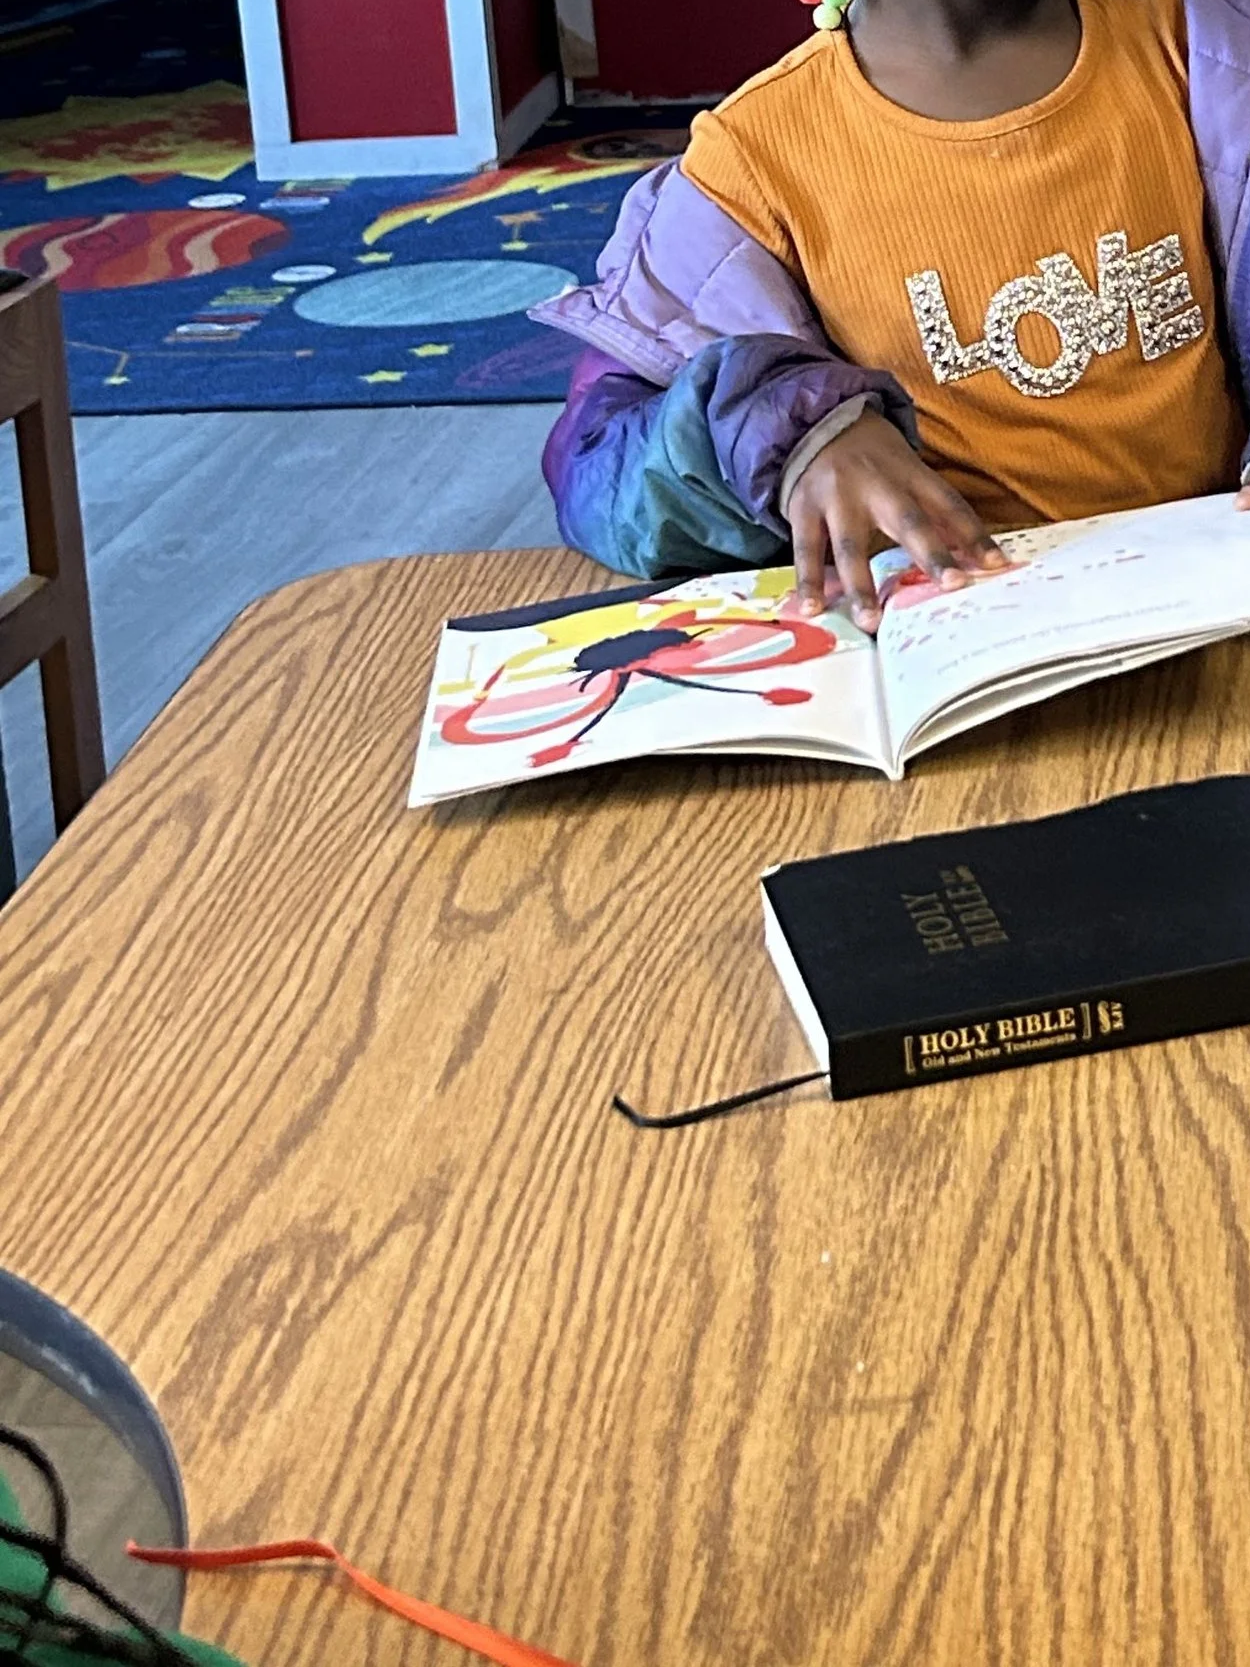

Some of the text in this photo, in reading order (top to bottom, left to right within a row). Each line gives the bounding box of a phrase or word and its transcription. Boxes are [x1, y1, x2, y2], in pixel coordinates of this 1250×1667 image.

[905, 230, 1204, 398] LOVE
[900, 891, 965, 954] HOLY
[919, 1007, 1077, 1056] HOLY BIBLE
[921, 1053, 946, 1070] Old
[948, 1048, 972, 1065] and
[973, 1045, 1001, 1061] New
